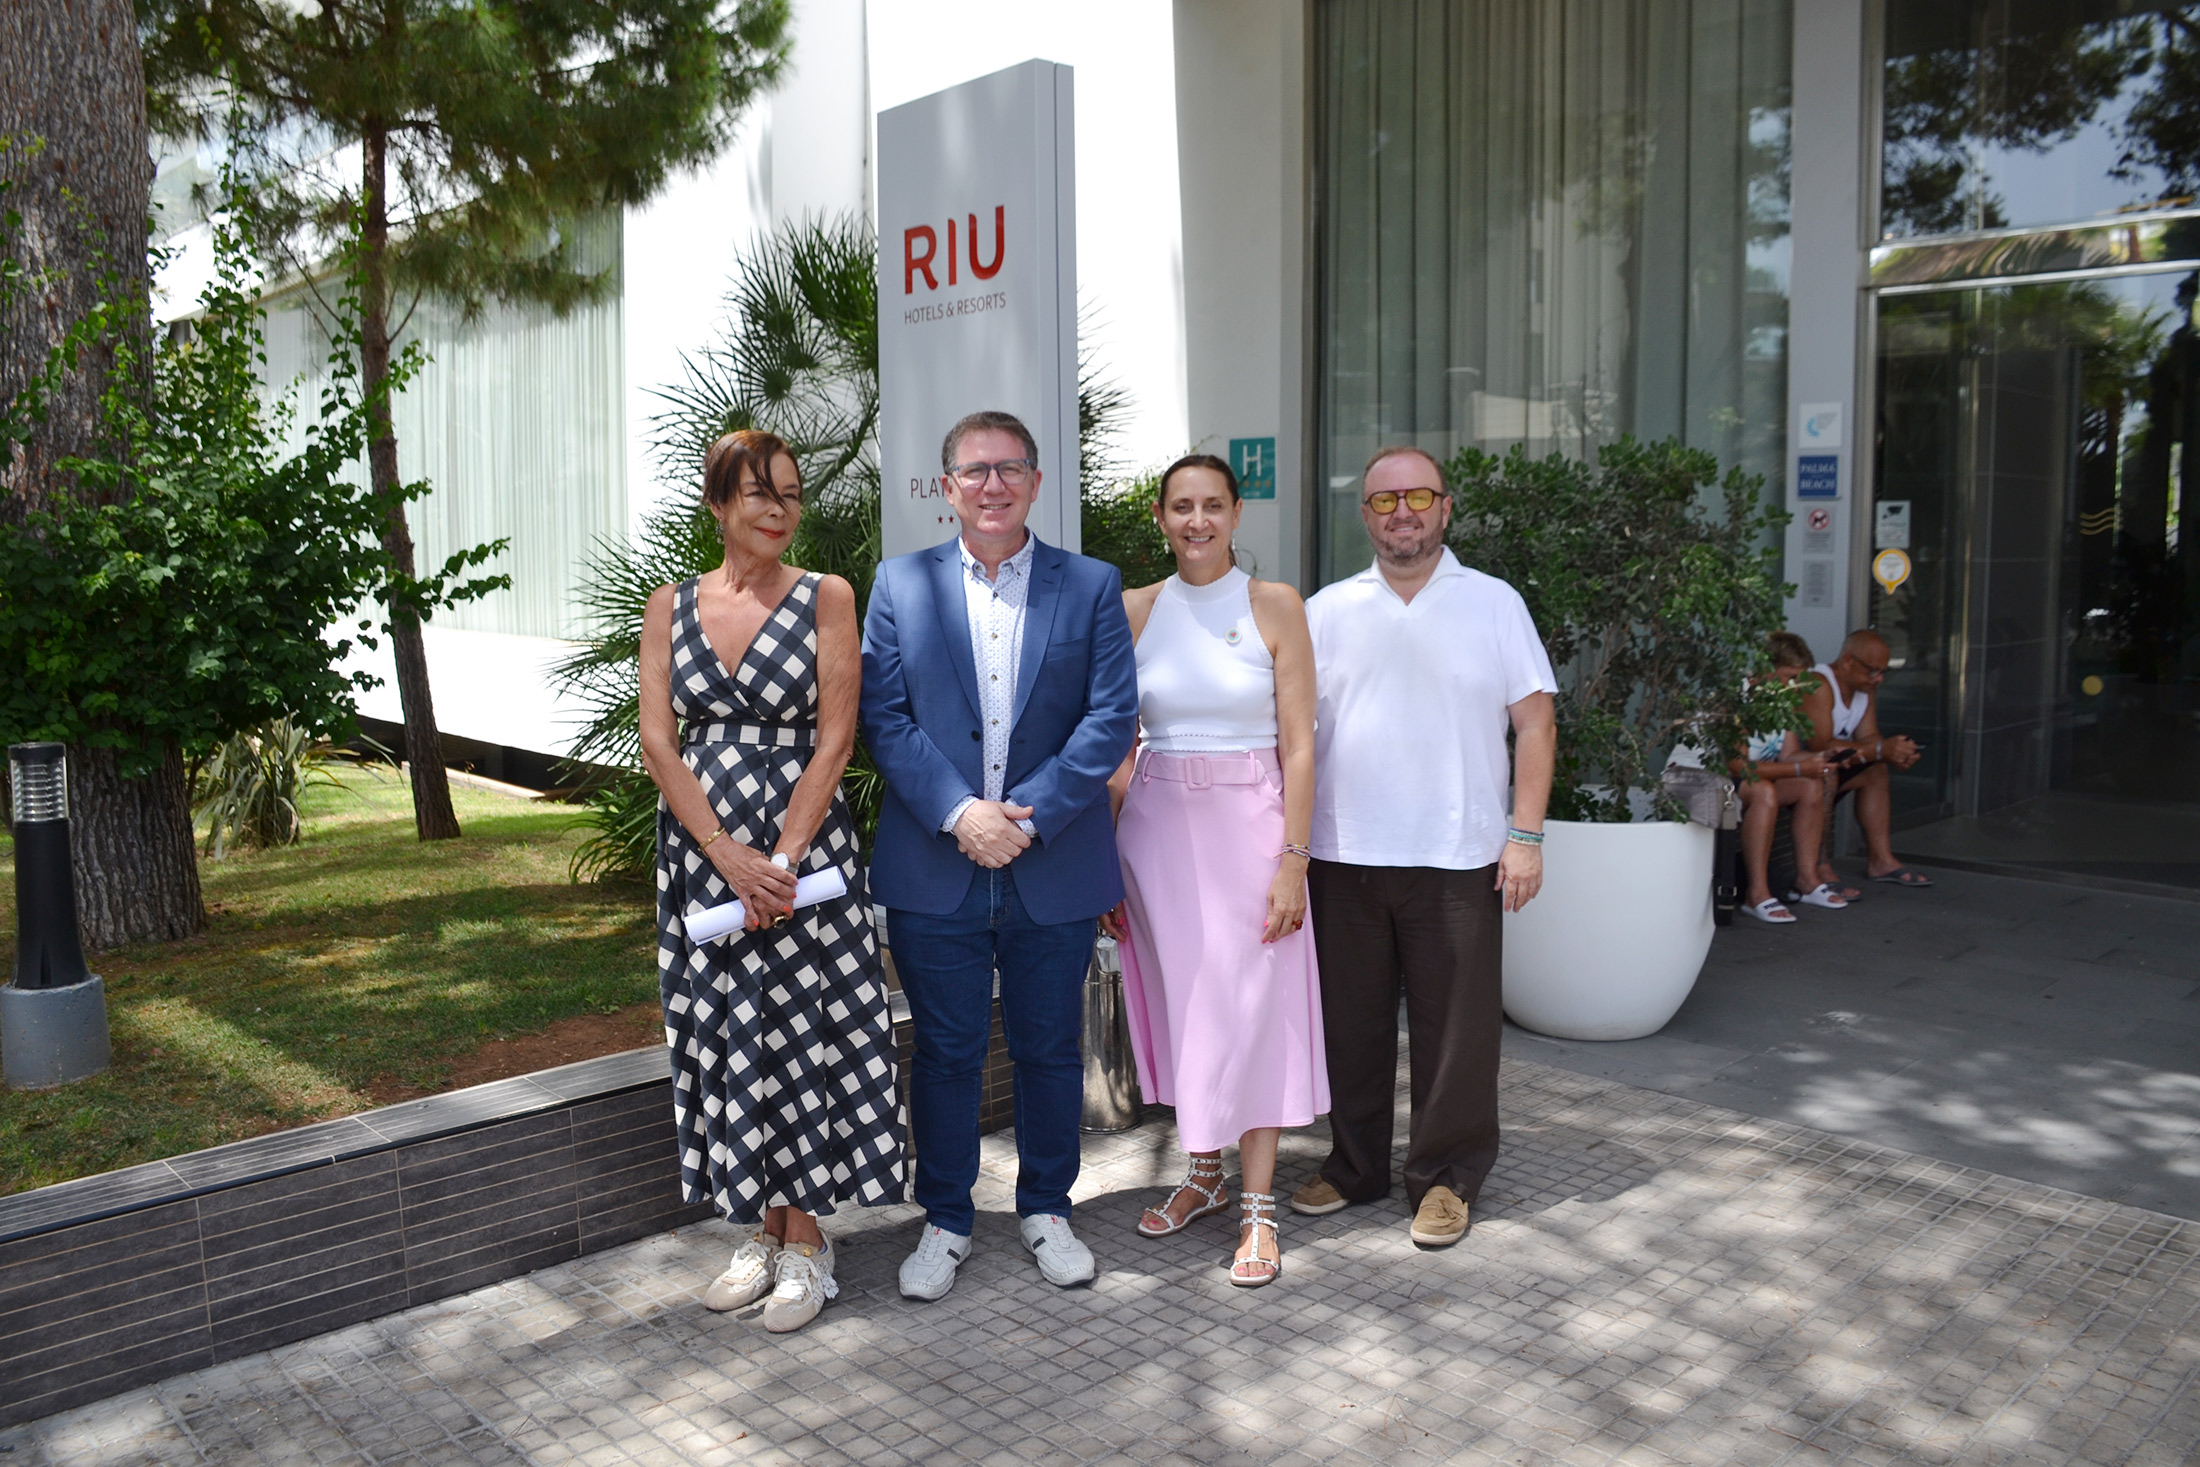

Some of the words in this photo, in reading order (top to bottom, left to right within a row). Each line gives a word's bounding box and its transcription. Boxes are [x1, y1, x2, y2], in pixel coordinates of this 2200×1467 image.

[904, 204, 1005, 295] RIU
[904, 303, 944, 325] HOTELS
[946, 301, 955, 318] &
[957, 291, 1006, 316] RESORTS
[1242, 444, 1262, 477] H
